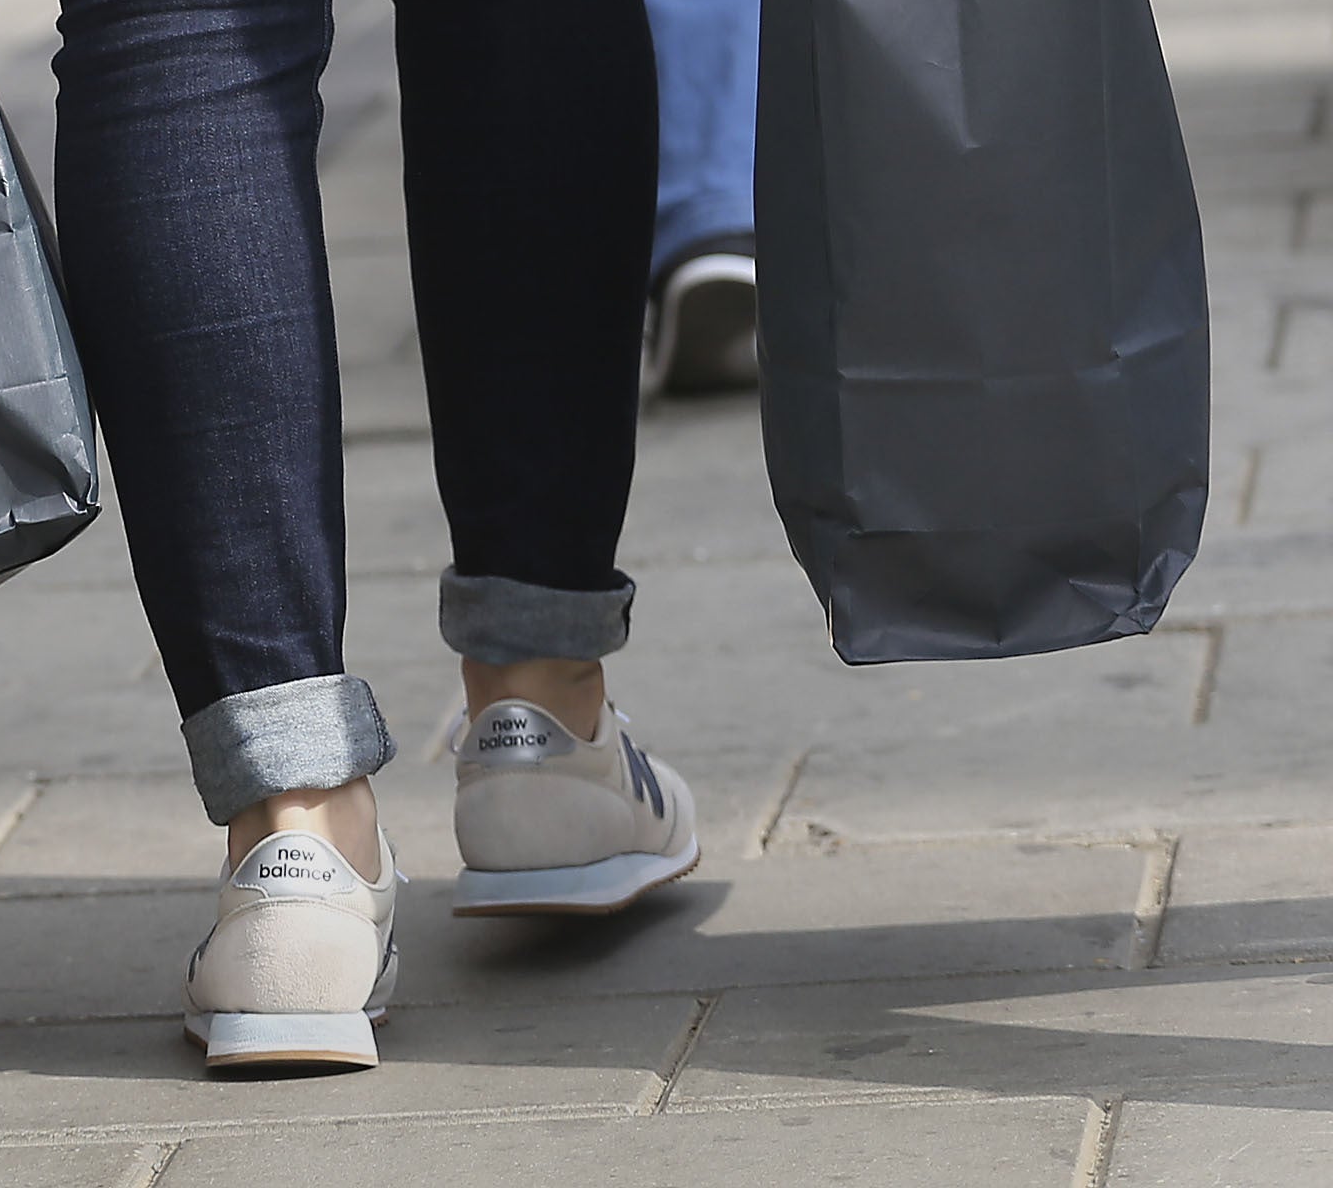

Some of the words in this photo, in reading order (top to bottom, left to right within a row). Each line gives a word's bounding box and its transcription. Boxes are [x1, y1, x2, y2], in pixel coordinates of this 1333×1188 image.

[491, 717, 527, 732] new
[478, 732, 547, 751] balance
[277, 848, 315, 861] new
[259, 863, 332, 882] balance
